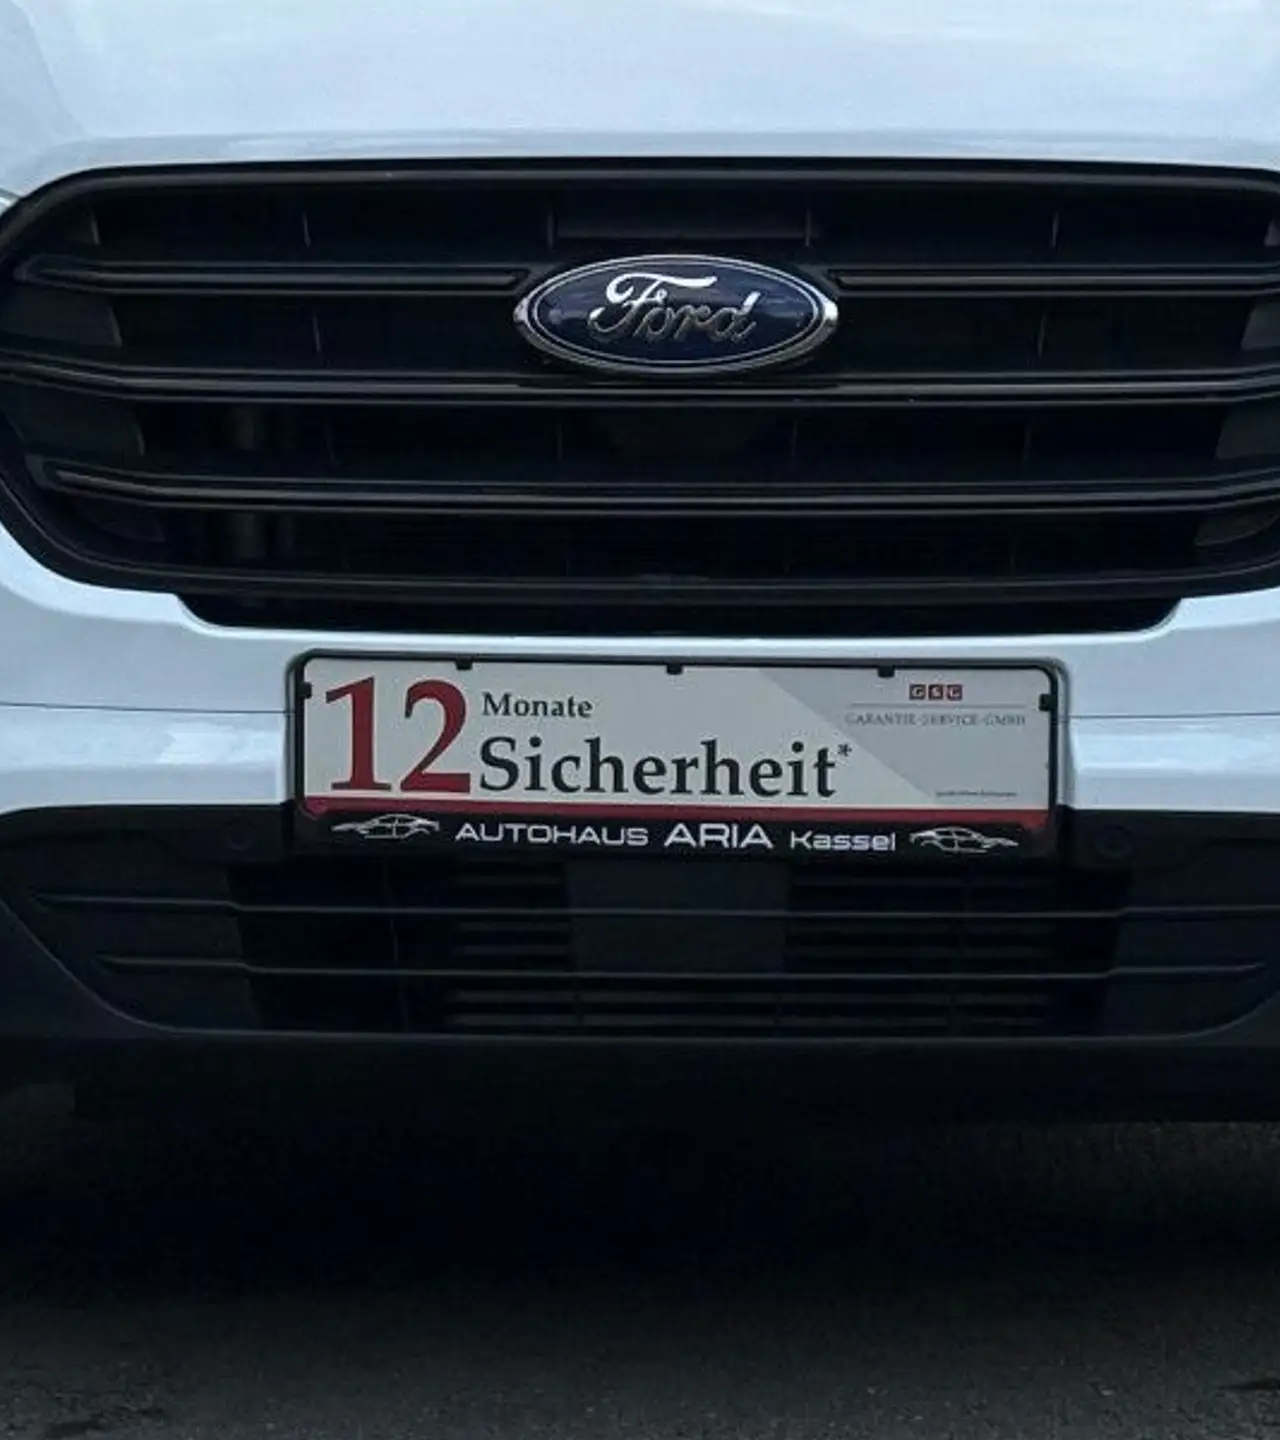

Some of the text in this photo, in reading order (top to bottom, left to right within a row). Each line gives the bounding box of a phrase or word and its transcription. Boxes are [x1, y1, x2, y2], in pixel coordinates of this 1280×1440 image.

[588, 273, 761, 341] Ford
[482, 691, 594, 718] Monate
[325, 675, 471, 794] 12
[455, 822, 897, 852] AUTOHAUS ARIA Kassel
